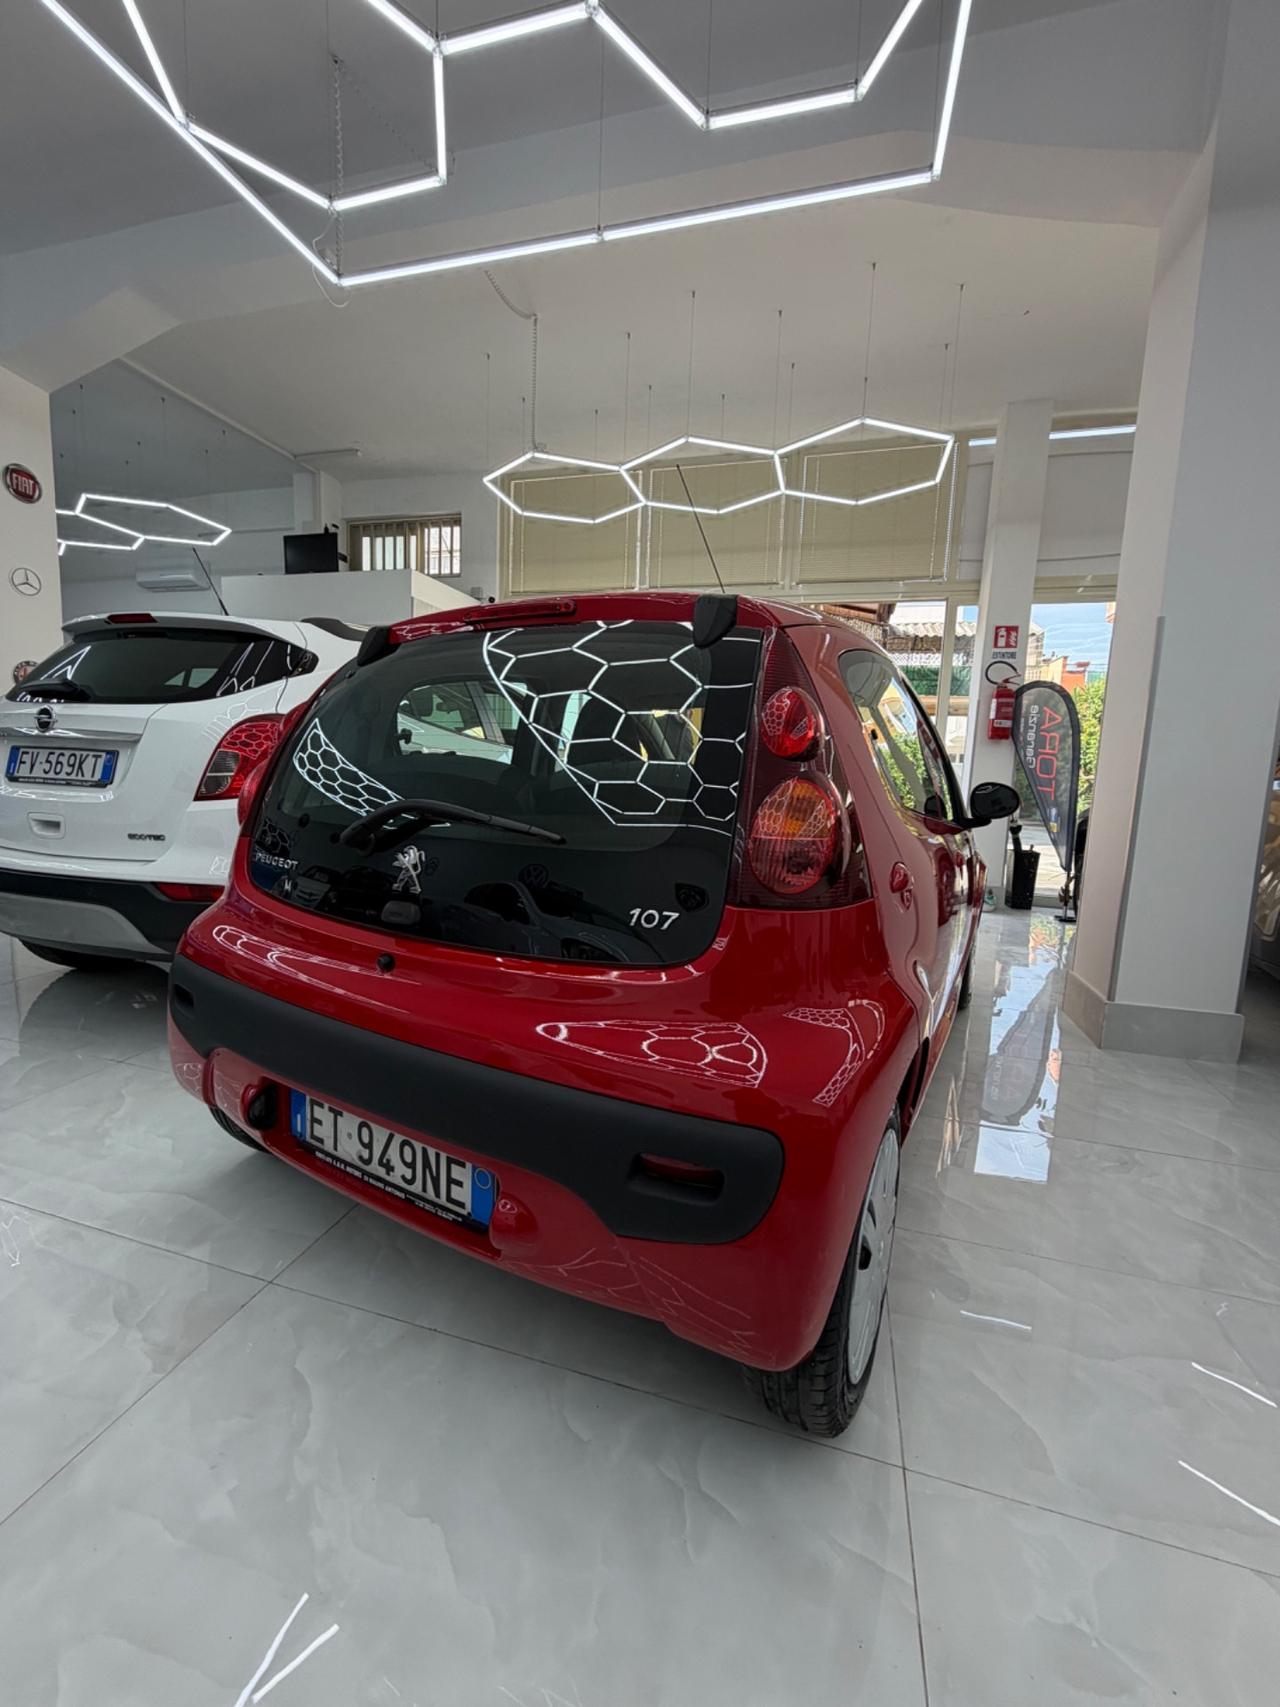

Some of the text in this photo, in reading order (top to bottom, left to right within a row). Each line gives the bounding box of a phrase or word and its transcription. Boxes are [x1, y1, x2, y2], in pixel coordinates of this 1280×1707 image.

[12, 472, 36, 496] FIAT
[255, 852, 299, 871] PEUGEOT
[628, 907, 680, 931] 107
